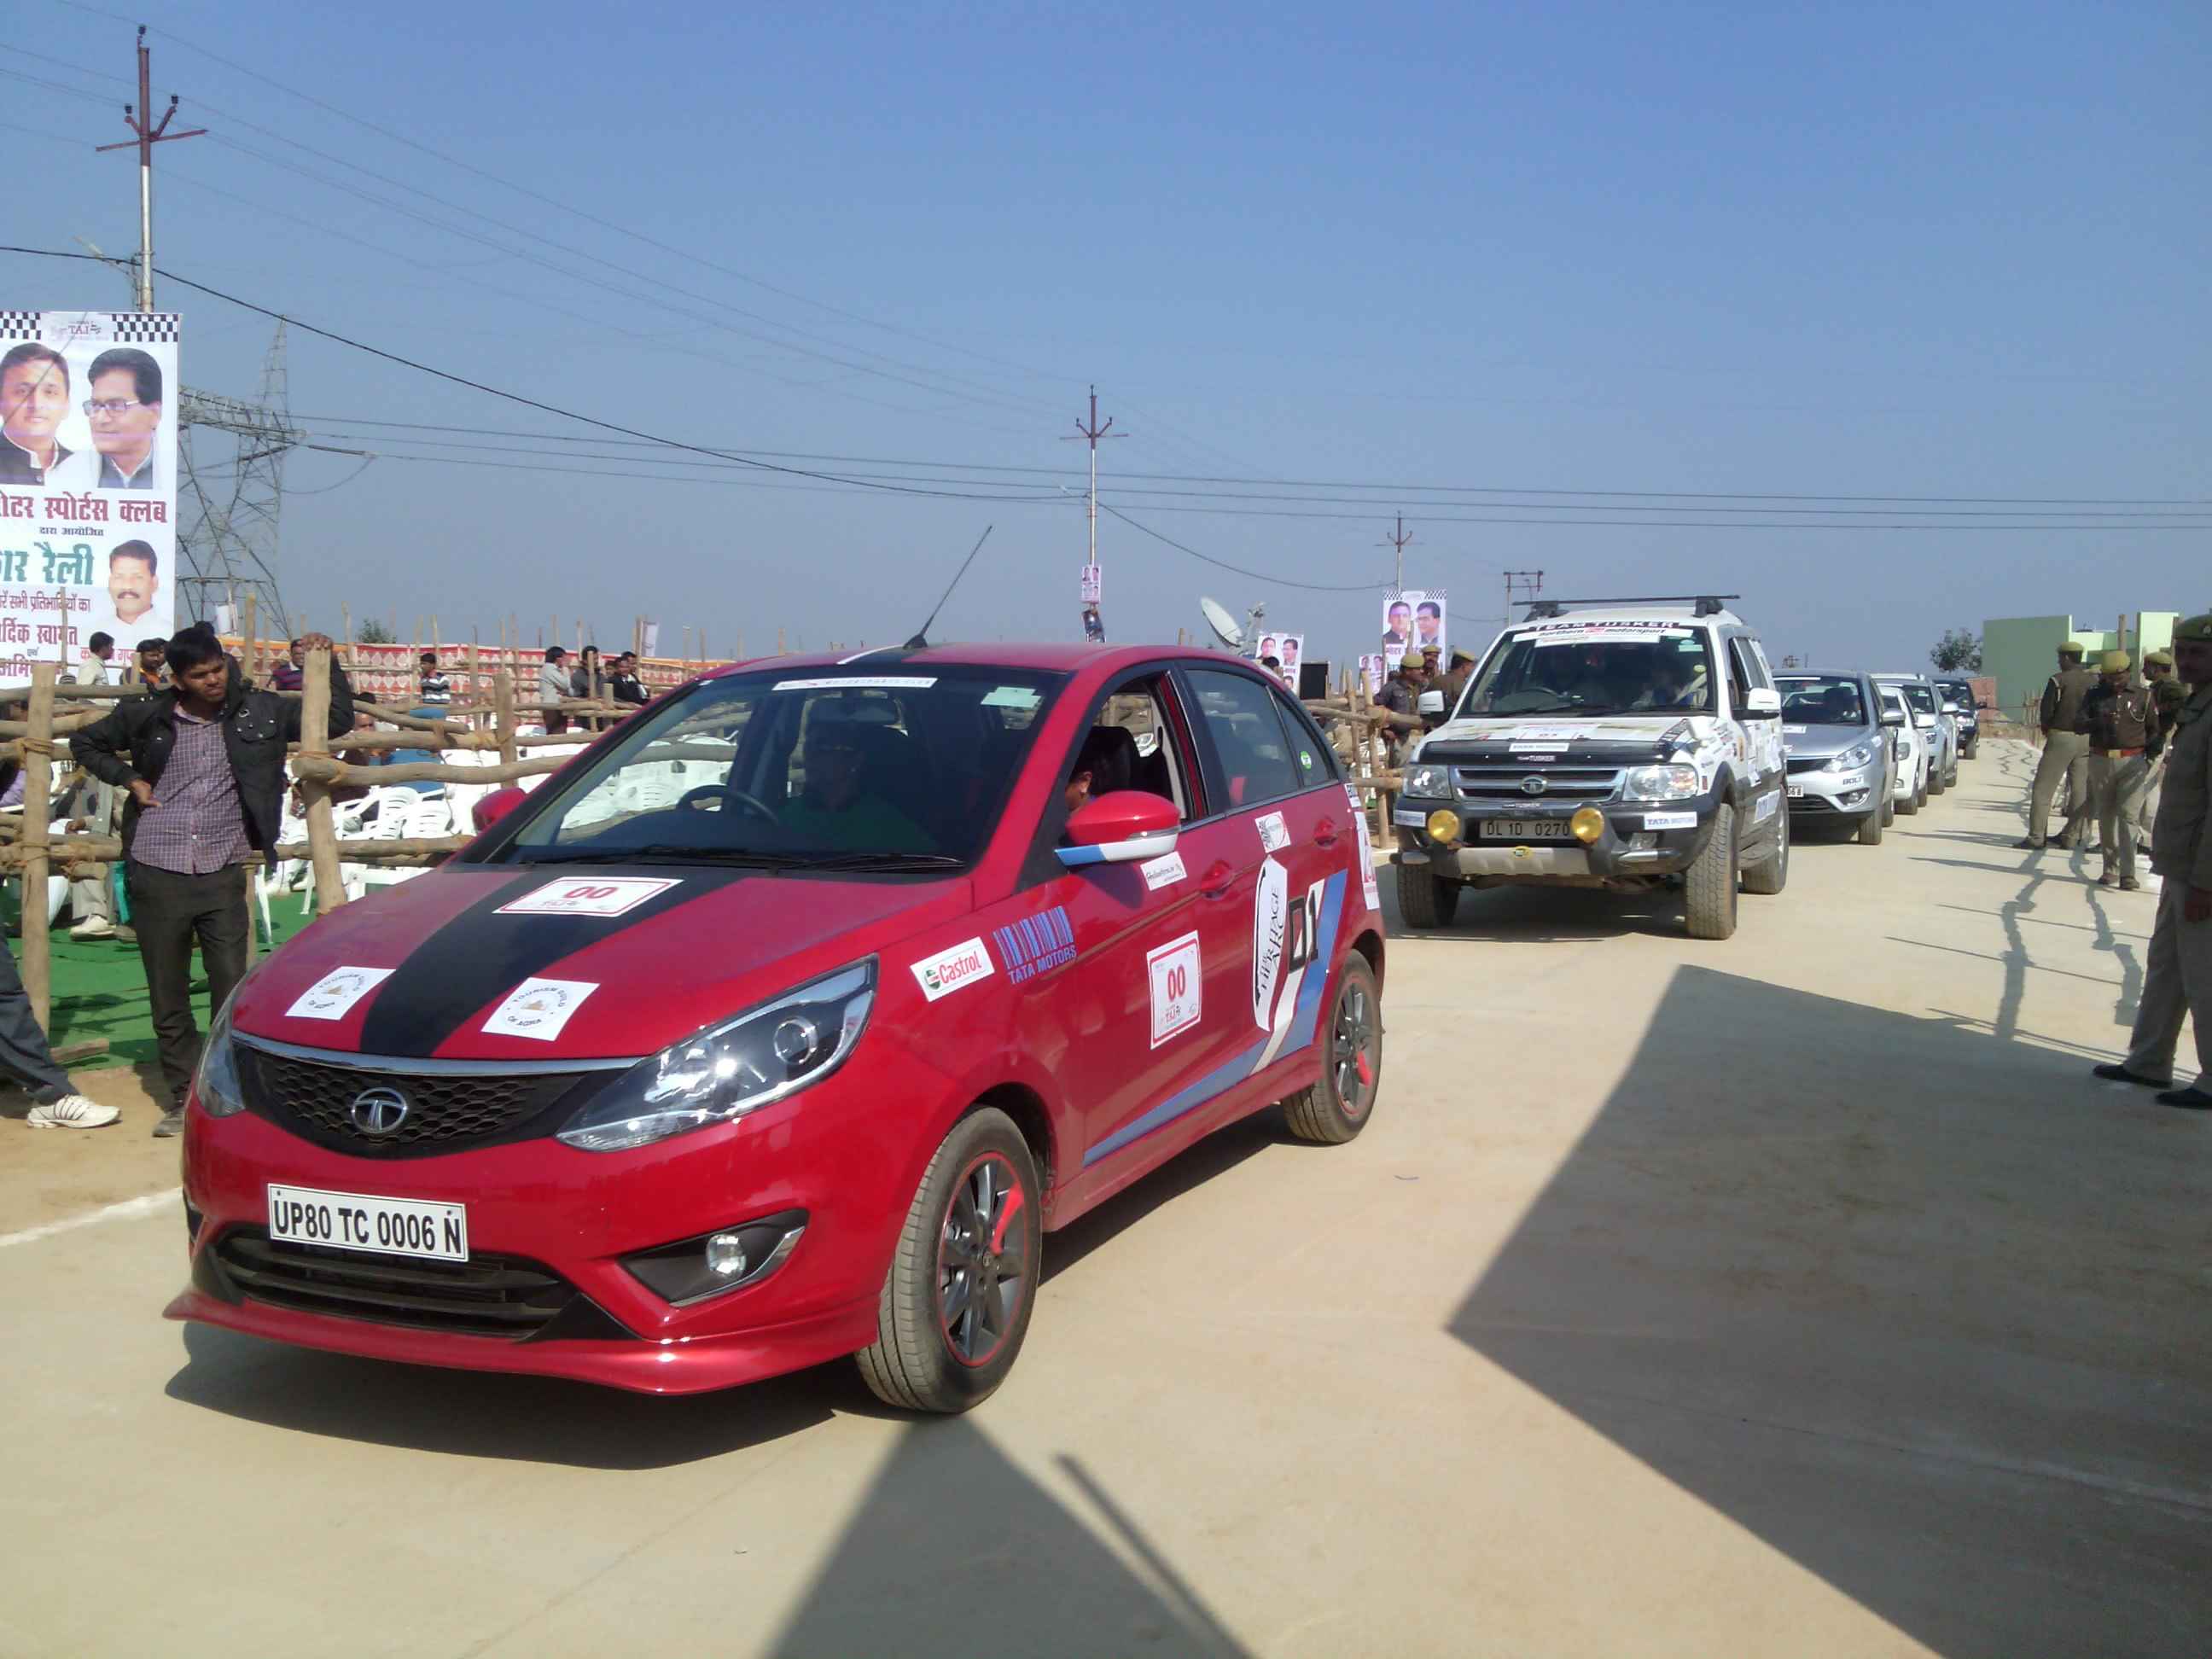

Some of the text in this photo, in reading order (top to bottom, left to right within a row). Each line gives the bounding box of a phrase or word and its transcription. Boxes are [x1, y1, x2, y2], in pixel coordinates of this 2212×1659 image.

[1593, 620, 1674, 629] TUSKER
[1842, 777, 1864, 786] BOLT
[1487, 822, 1502, 835] DL
[1534, 823, 1570, 836] 0270
[562, 886, 620, 899] 00
[939, 950, 982, 984] Castrol
[1008, 944, 1077, 985] TATA MOTORS
[1167, 963, 1185, 1003] 00
[274, 1200, 462, 1254] UP80 TC 0006 N
